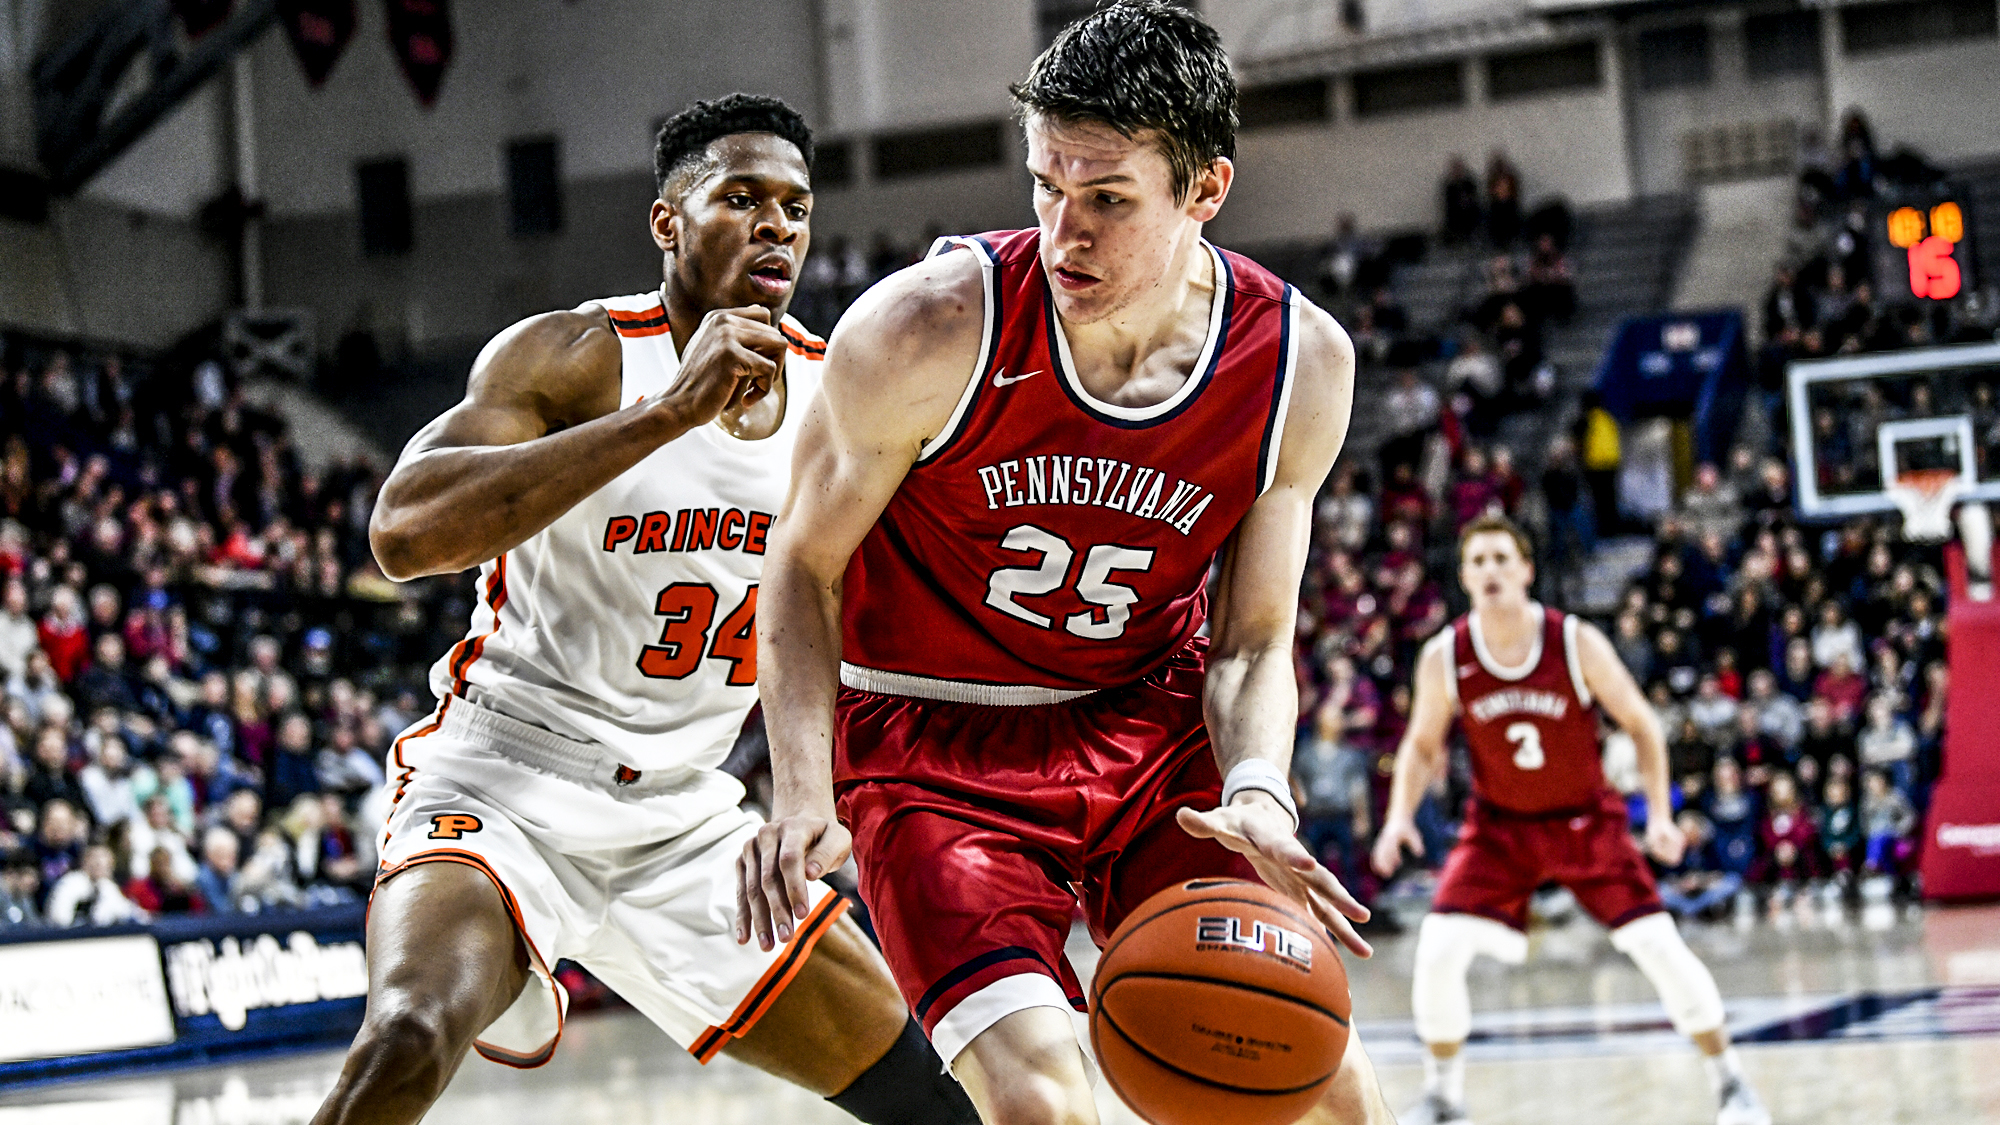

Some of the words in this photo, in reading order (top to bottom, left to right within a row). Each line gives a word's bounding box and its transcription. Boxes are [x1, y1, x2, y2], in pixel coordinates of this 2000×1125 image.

[978, 455, 1214, 536] PENNSYLVANIA
[603, 508, 777, 556] PRINCE
[982, 523, 1157, 640] 25
[636, 581, 758, 686] 34
[1505, 721, 1545, 770] 3
[428, 813, 483, 840] P
[1196, 916, 1313, 969] ELITE
